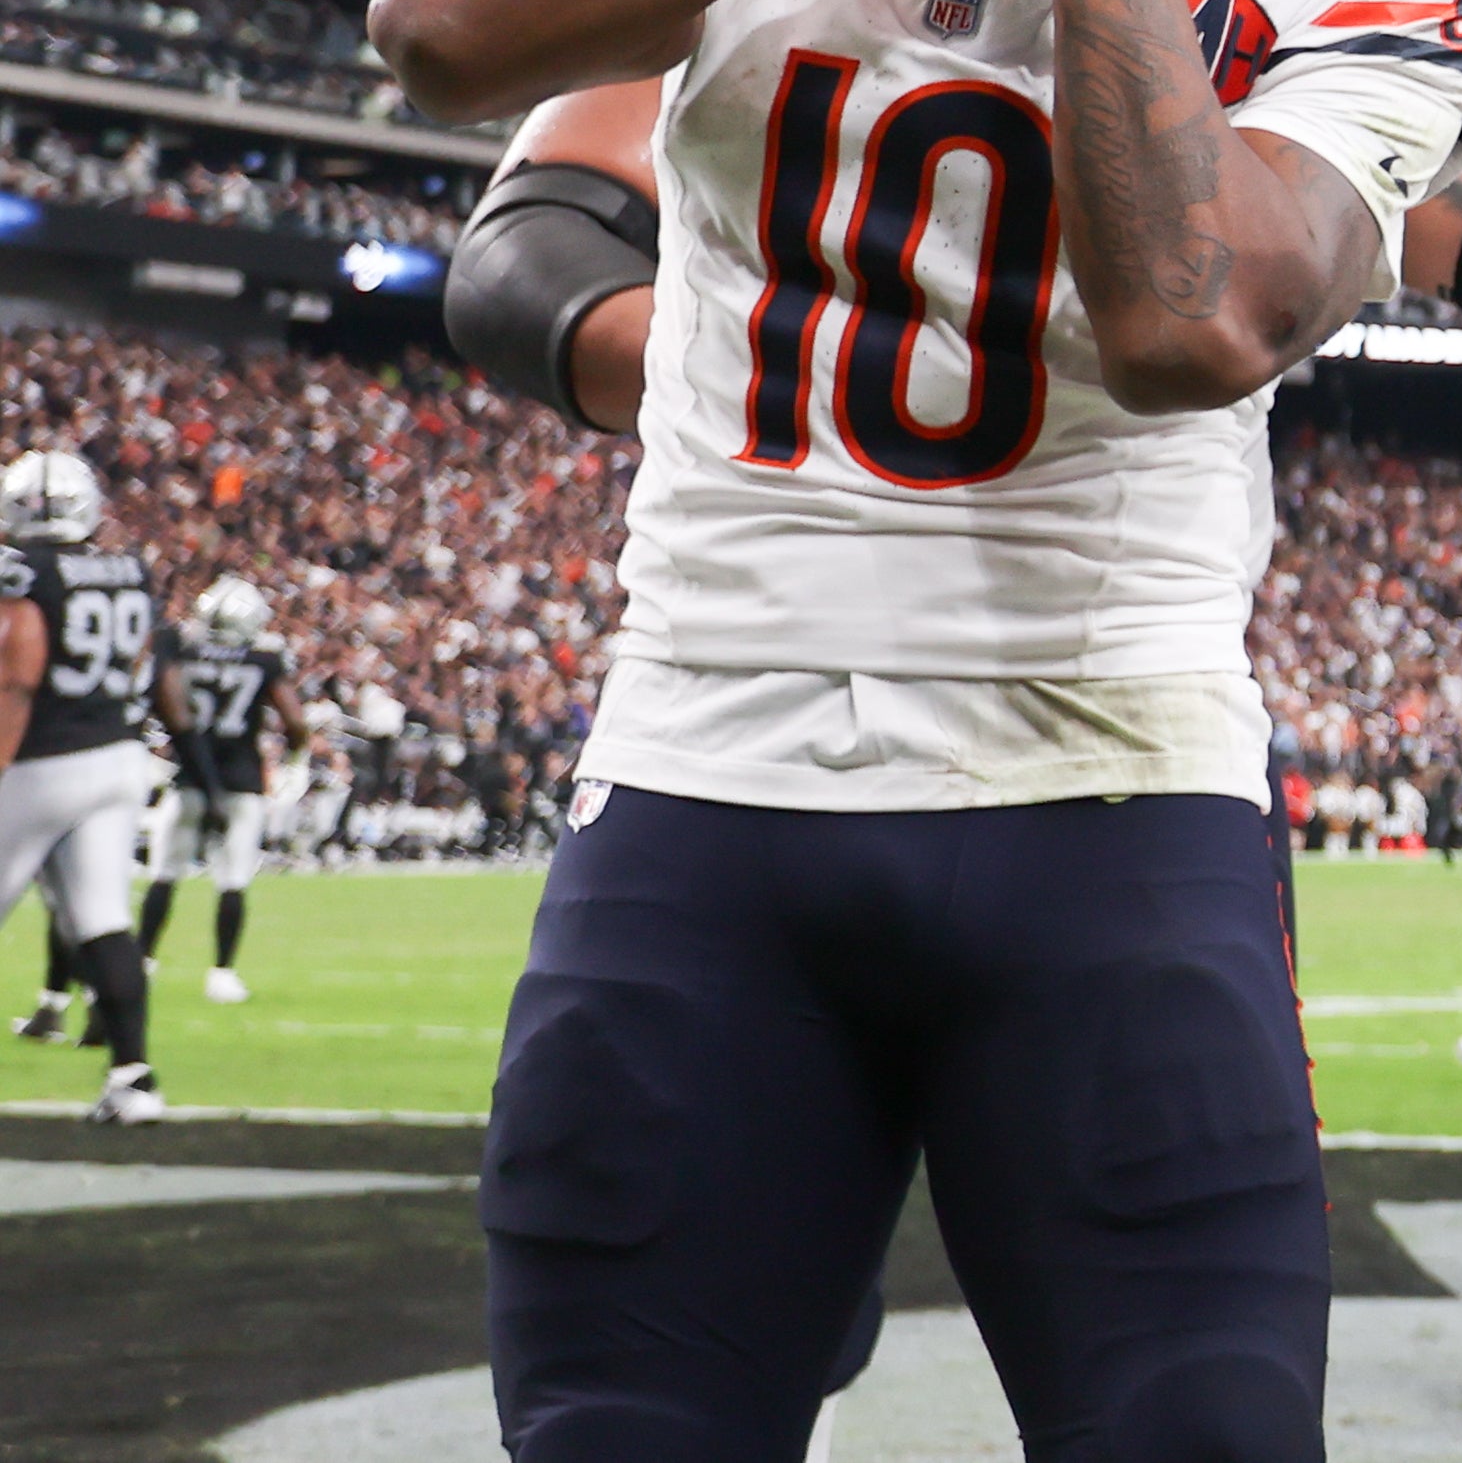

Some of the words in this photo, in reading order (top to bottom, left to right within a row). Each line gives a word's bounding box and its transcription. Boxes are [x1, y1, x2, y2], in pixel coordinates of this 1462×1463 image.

[931, 0, 977, 32] NFL
[731, 48, 1060, 491] 10
[50, 589, 153, 699] 99
